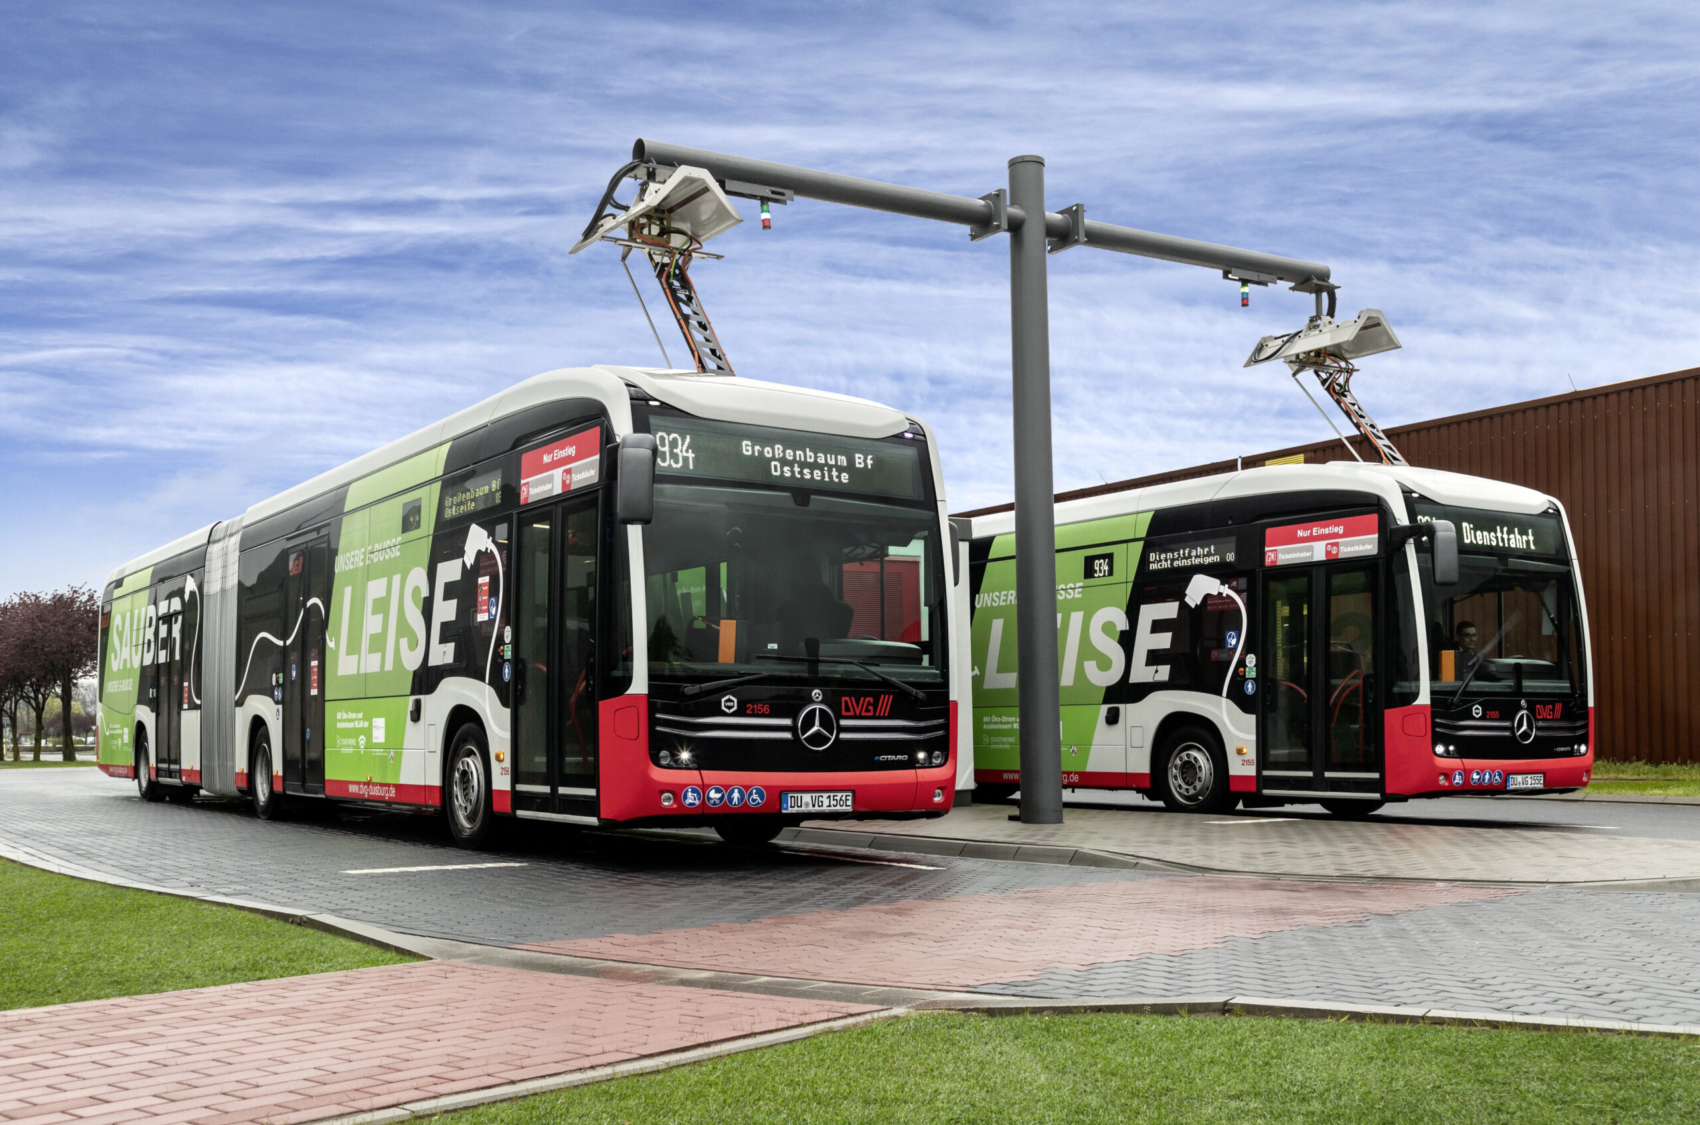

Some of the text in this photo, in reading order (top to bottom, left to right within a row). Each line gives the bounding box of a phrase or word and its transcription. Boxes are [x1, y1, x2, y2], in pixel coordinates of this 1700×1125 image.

[543, 445, 576, 464] Nur Einstieg
[656, 432, 695, 470] 934
[742, 440, 873, 469] Großenbaum Bf
[771, 461, 849, 483] Ostseite
[1297, 525, 1343, 537] Nur Einstieg
[1462, 522, 1535, 550] Dienstfahrt
[335, 536, 402, 573] UNSERE E-BUSSE
[1150, 545, 1215, 562] Dienstfahrt
[1278, 544, 1373, 560] Ticketinhaber Ticketkäufer
[1094, 559, 1108, 577] 934
[1150, 559, 1171, 570] nicht
[1173, 555, 1220, 568] einsteigen
[975, 590, 1018, 608] UNSER
[337, 558, 463, 676] LEISE
[111, 597, 183, 672] SAUBER
[983, 601, 1180, 689] LISE
[746, 704, 770, 714] 2156
[1510, 776, 1543, 787] DU VG 155E
[789, 794, 851, 808] DU VG 156E
